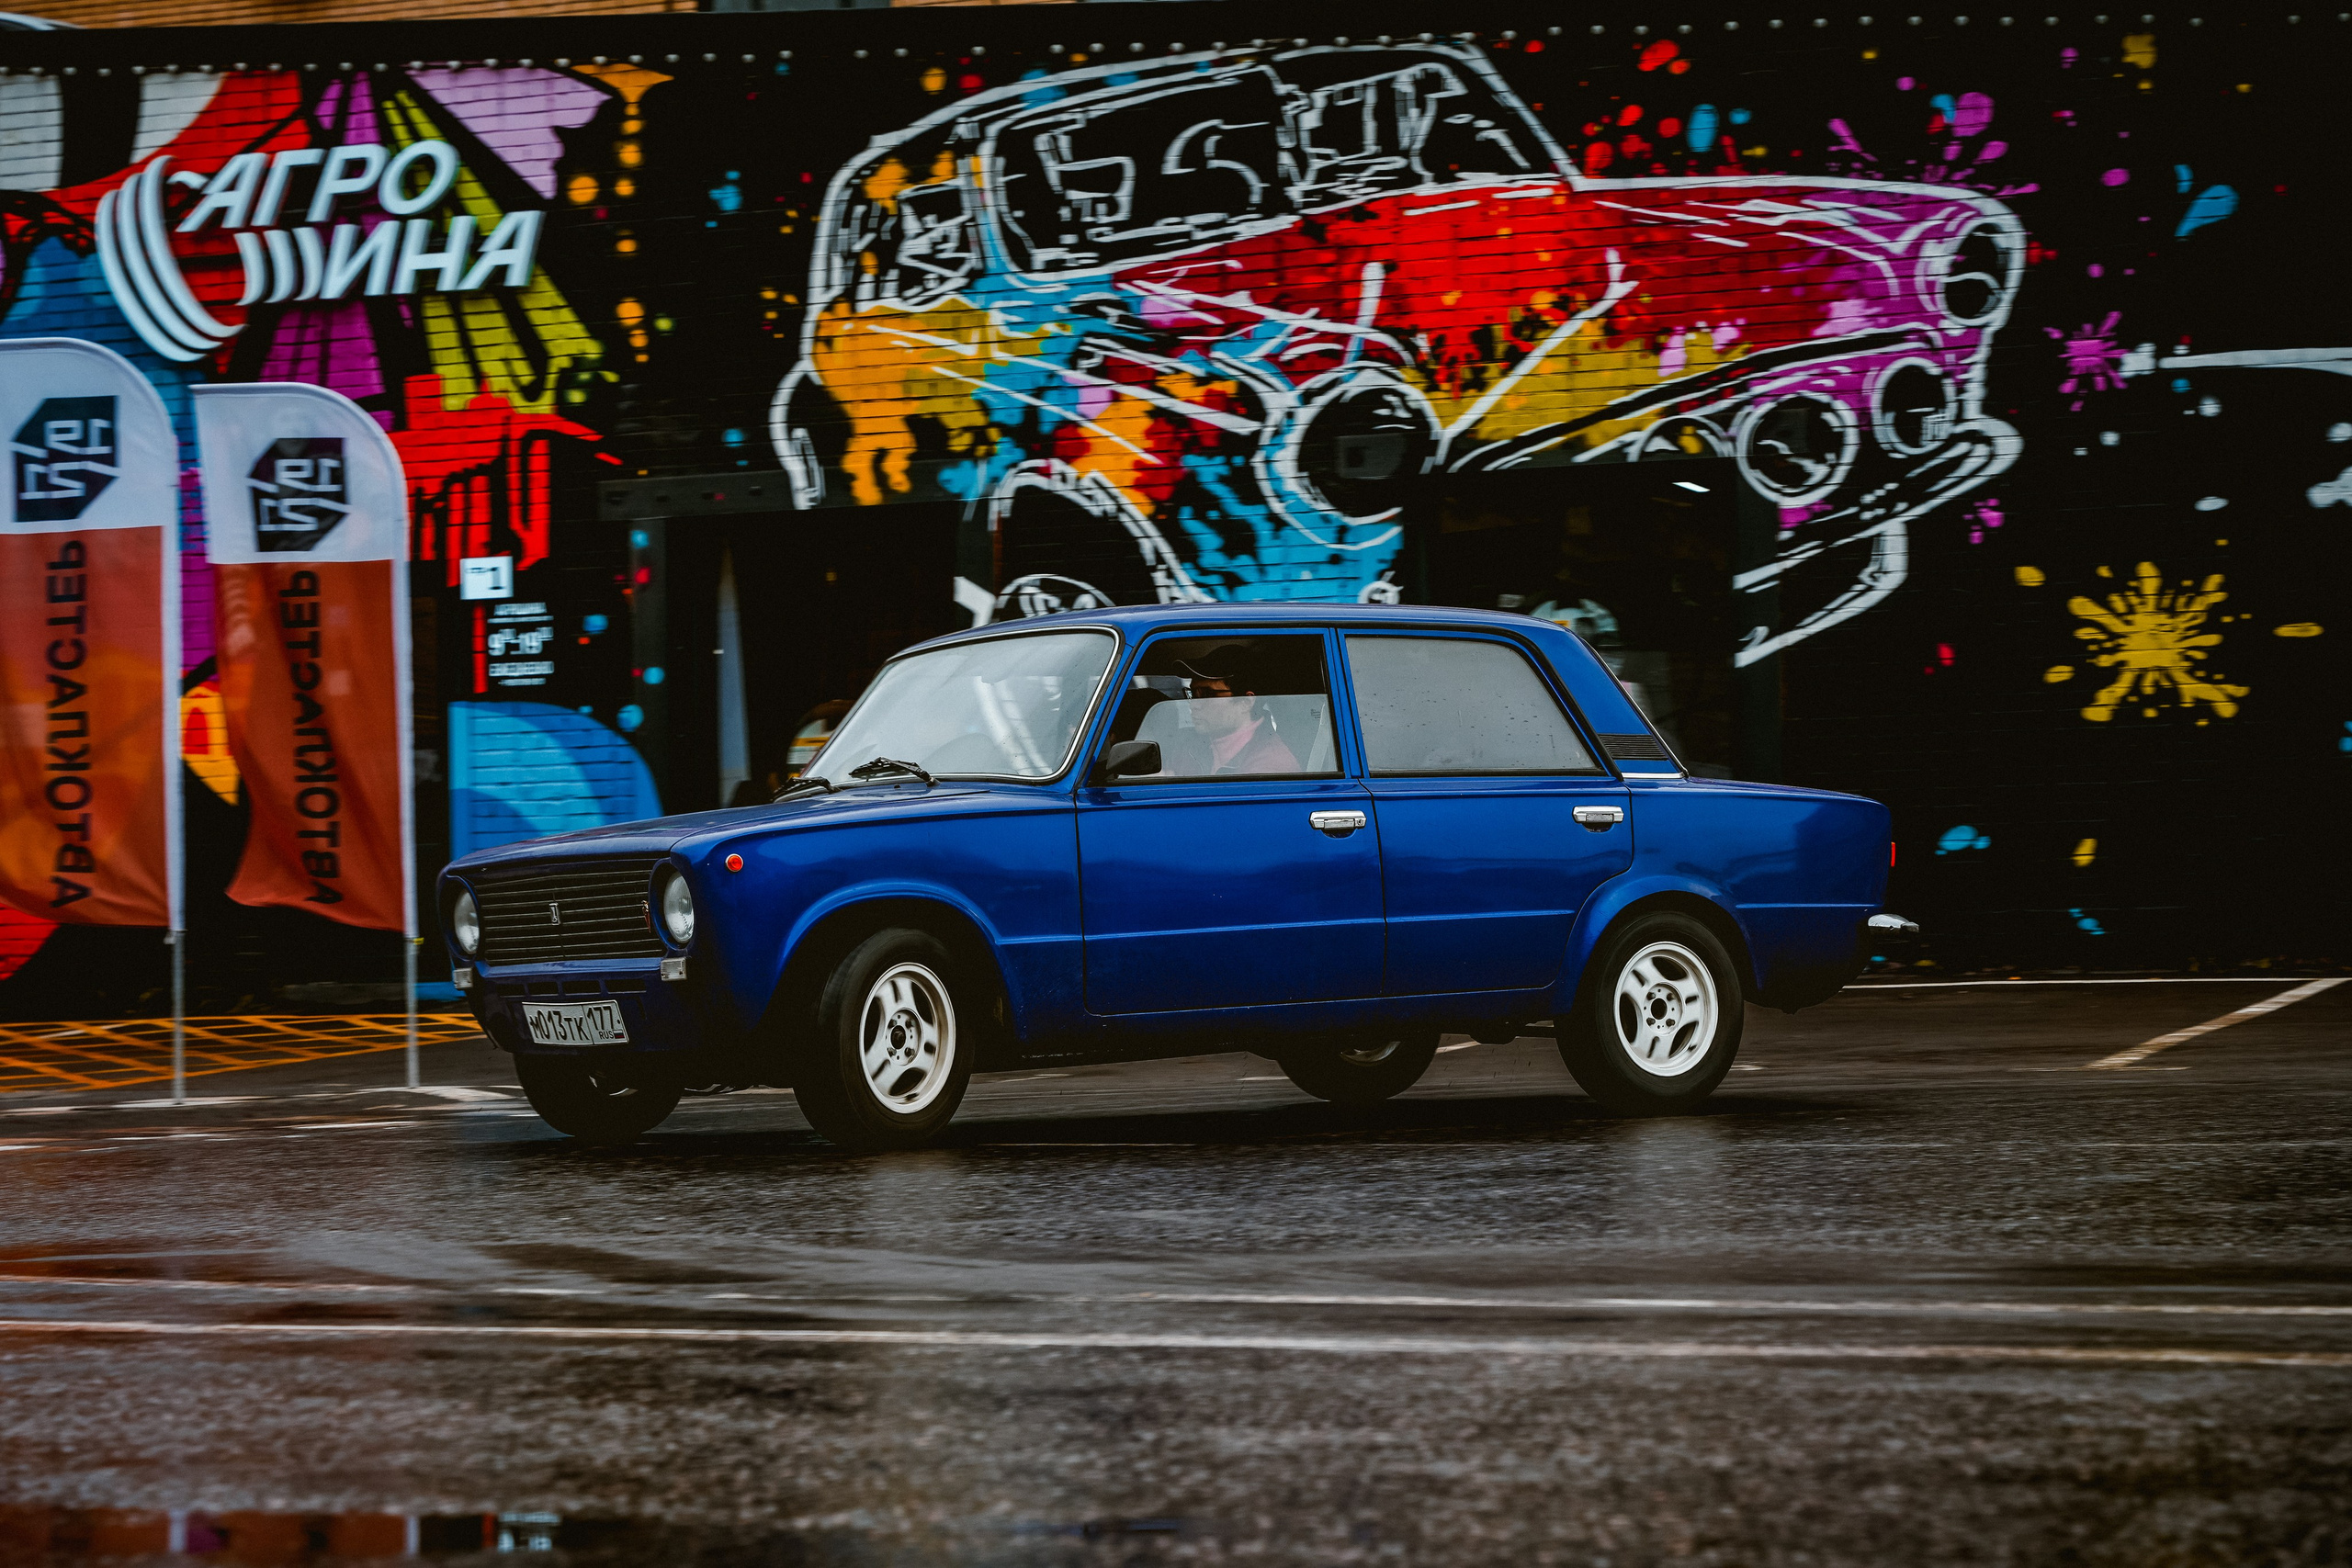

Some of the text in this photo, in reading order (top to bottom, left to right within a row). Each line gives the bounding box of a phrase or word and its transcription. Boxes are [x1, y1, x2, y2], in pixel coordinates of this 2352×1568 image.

[175, 139, 459, 233] АГРО
[233, 209, 546, 306] ШИНА
[529, 1006, 614, 1041] М013ТК 177
[598, 1031, 615, 1040] RUS
